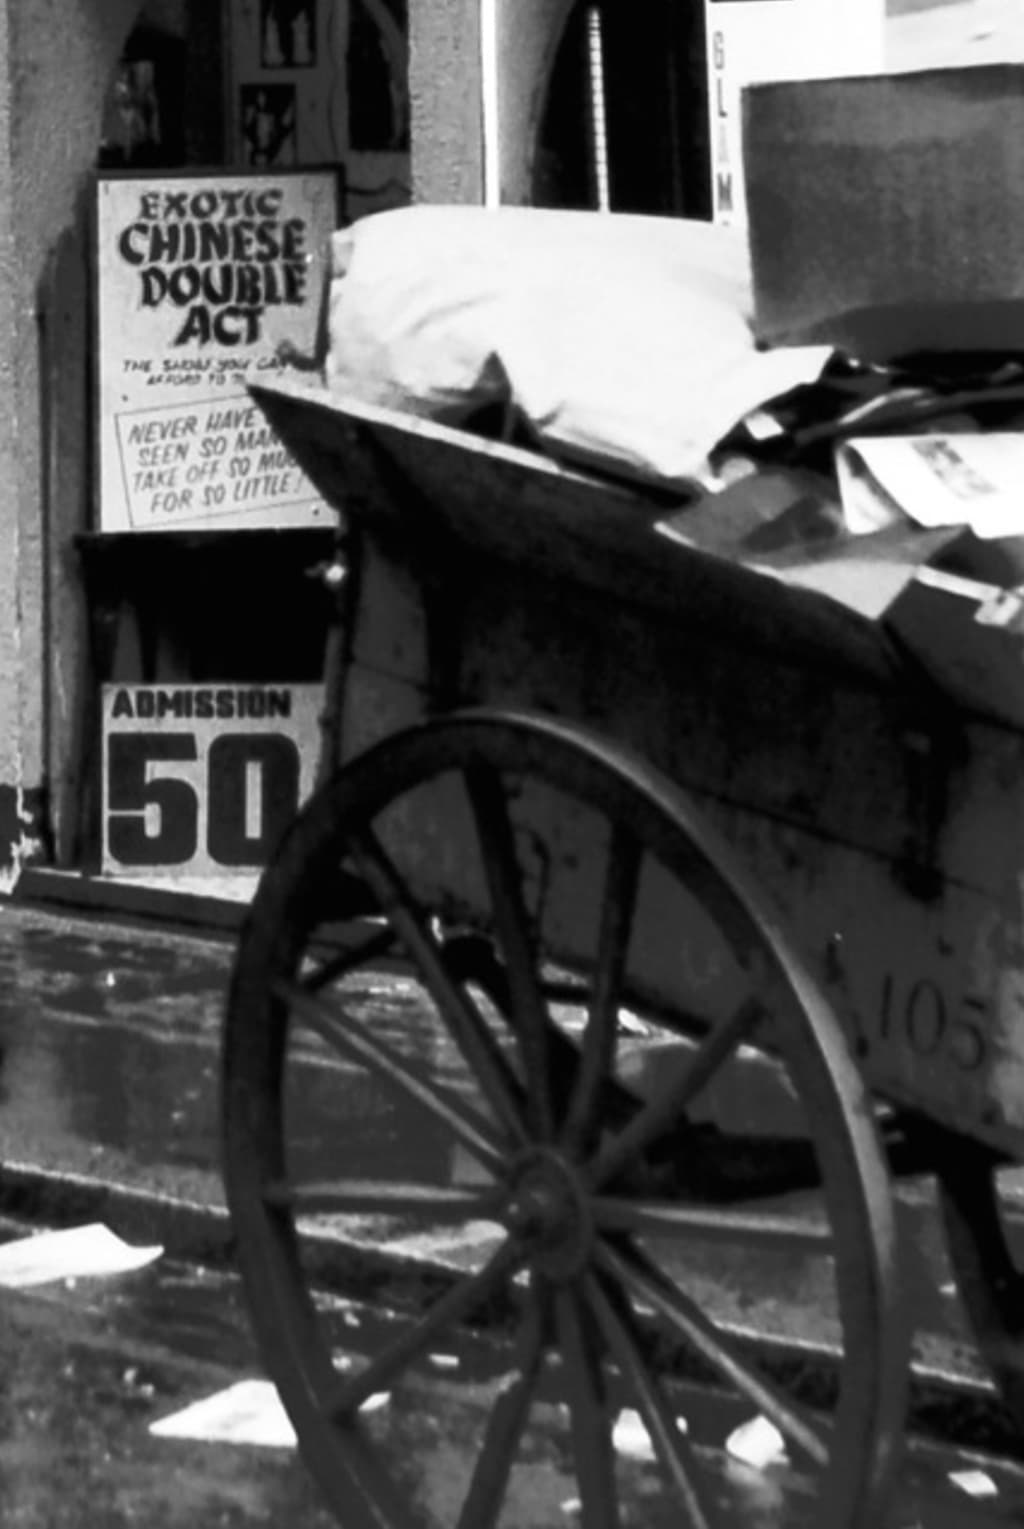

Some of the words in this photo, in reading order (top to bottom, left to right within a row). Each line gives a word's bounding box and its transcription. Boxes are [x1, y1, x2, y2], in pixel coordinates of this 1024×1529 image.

[139, 187, 284, 219] EXOTIC
[118, 218, 306, 265] CHINESE
[139, 263, 307, 309] DOUBLE
[172, 305, 264, 348] ACT
[128, 415, 199, 445] NEVER
[205, 406, 258, 433] HAVE
[138, 442, 190, 467] SEEN
[199, 436, 227, 458] SO
[133, 467, 181, 493] TAKE
[186, 460, 222, 484] OFF
[228, 456, 251, 478] SO
[151, 488, 193, 513] FOR
[202, 485, 227, 506] SO
[110, 687, 292, 720] ADMISSION
[107, 732, 301, 867] 50
